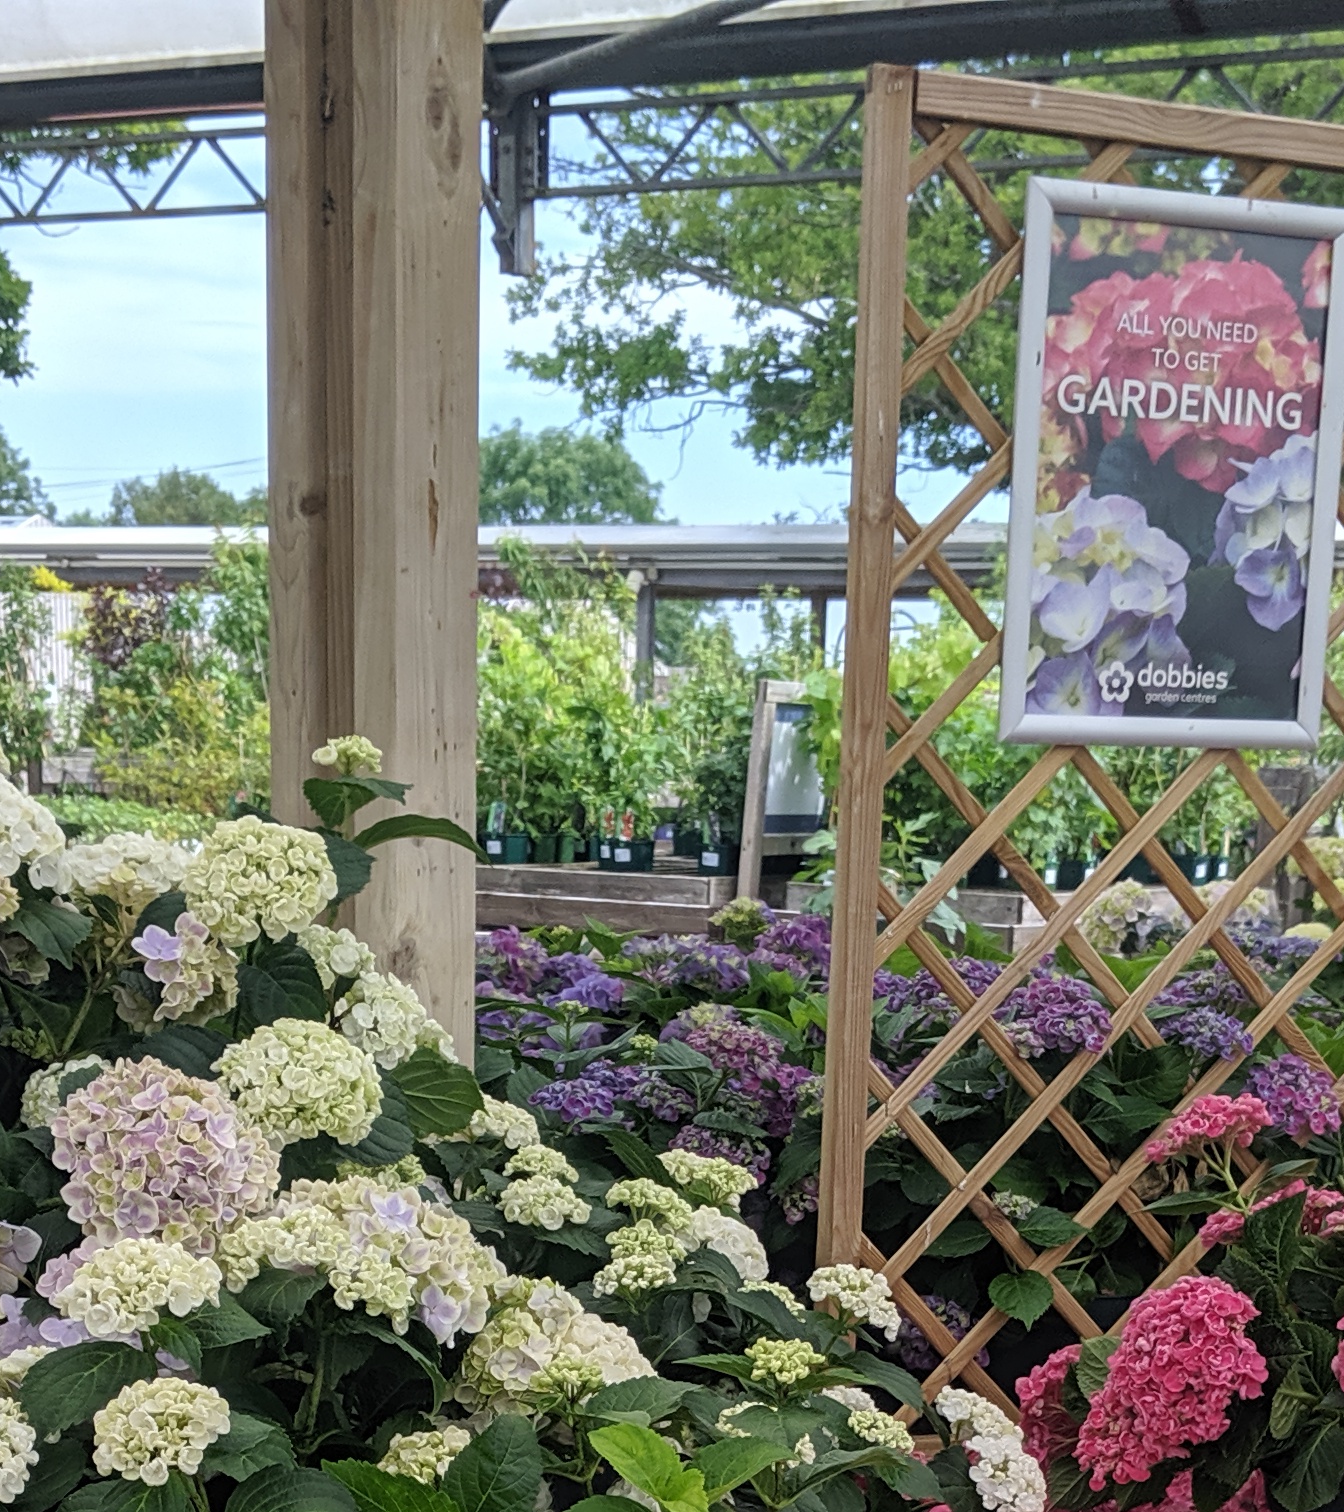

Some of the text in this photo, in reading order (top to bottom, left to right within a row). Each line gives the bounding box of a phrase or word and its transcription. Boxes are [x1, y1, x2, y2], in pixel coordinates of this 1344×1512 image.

[1117, 312, 1257, 344] ALL YOU NEED
[1152, 348, 1222, 373] TO GET
[1057, 374, 1303, 431] GARDENING
[1137, 661, 1229, 690] dobbies
[1144, 692, 1217, 704] garden centres
